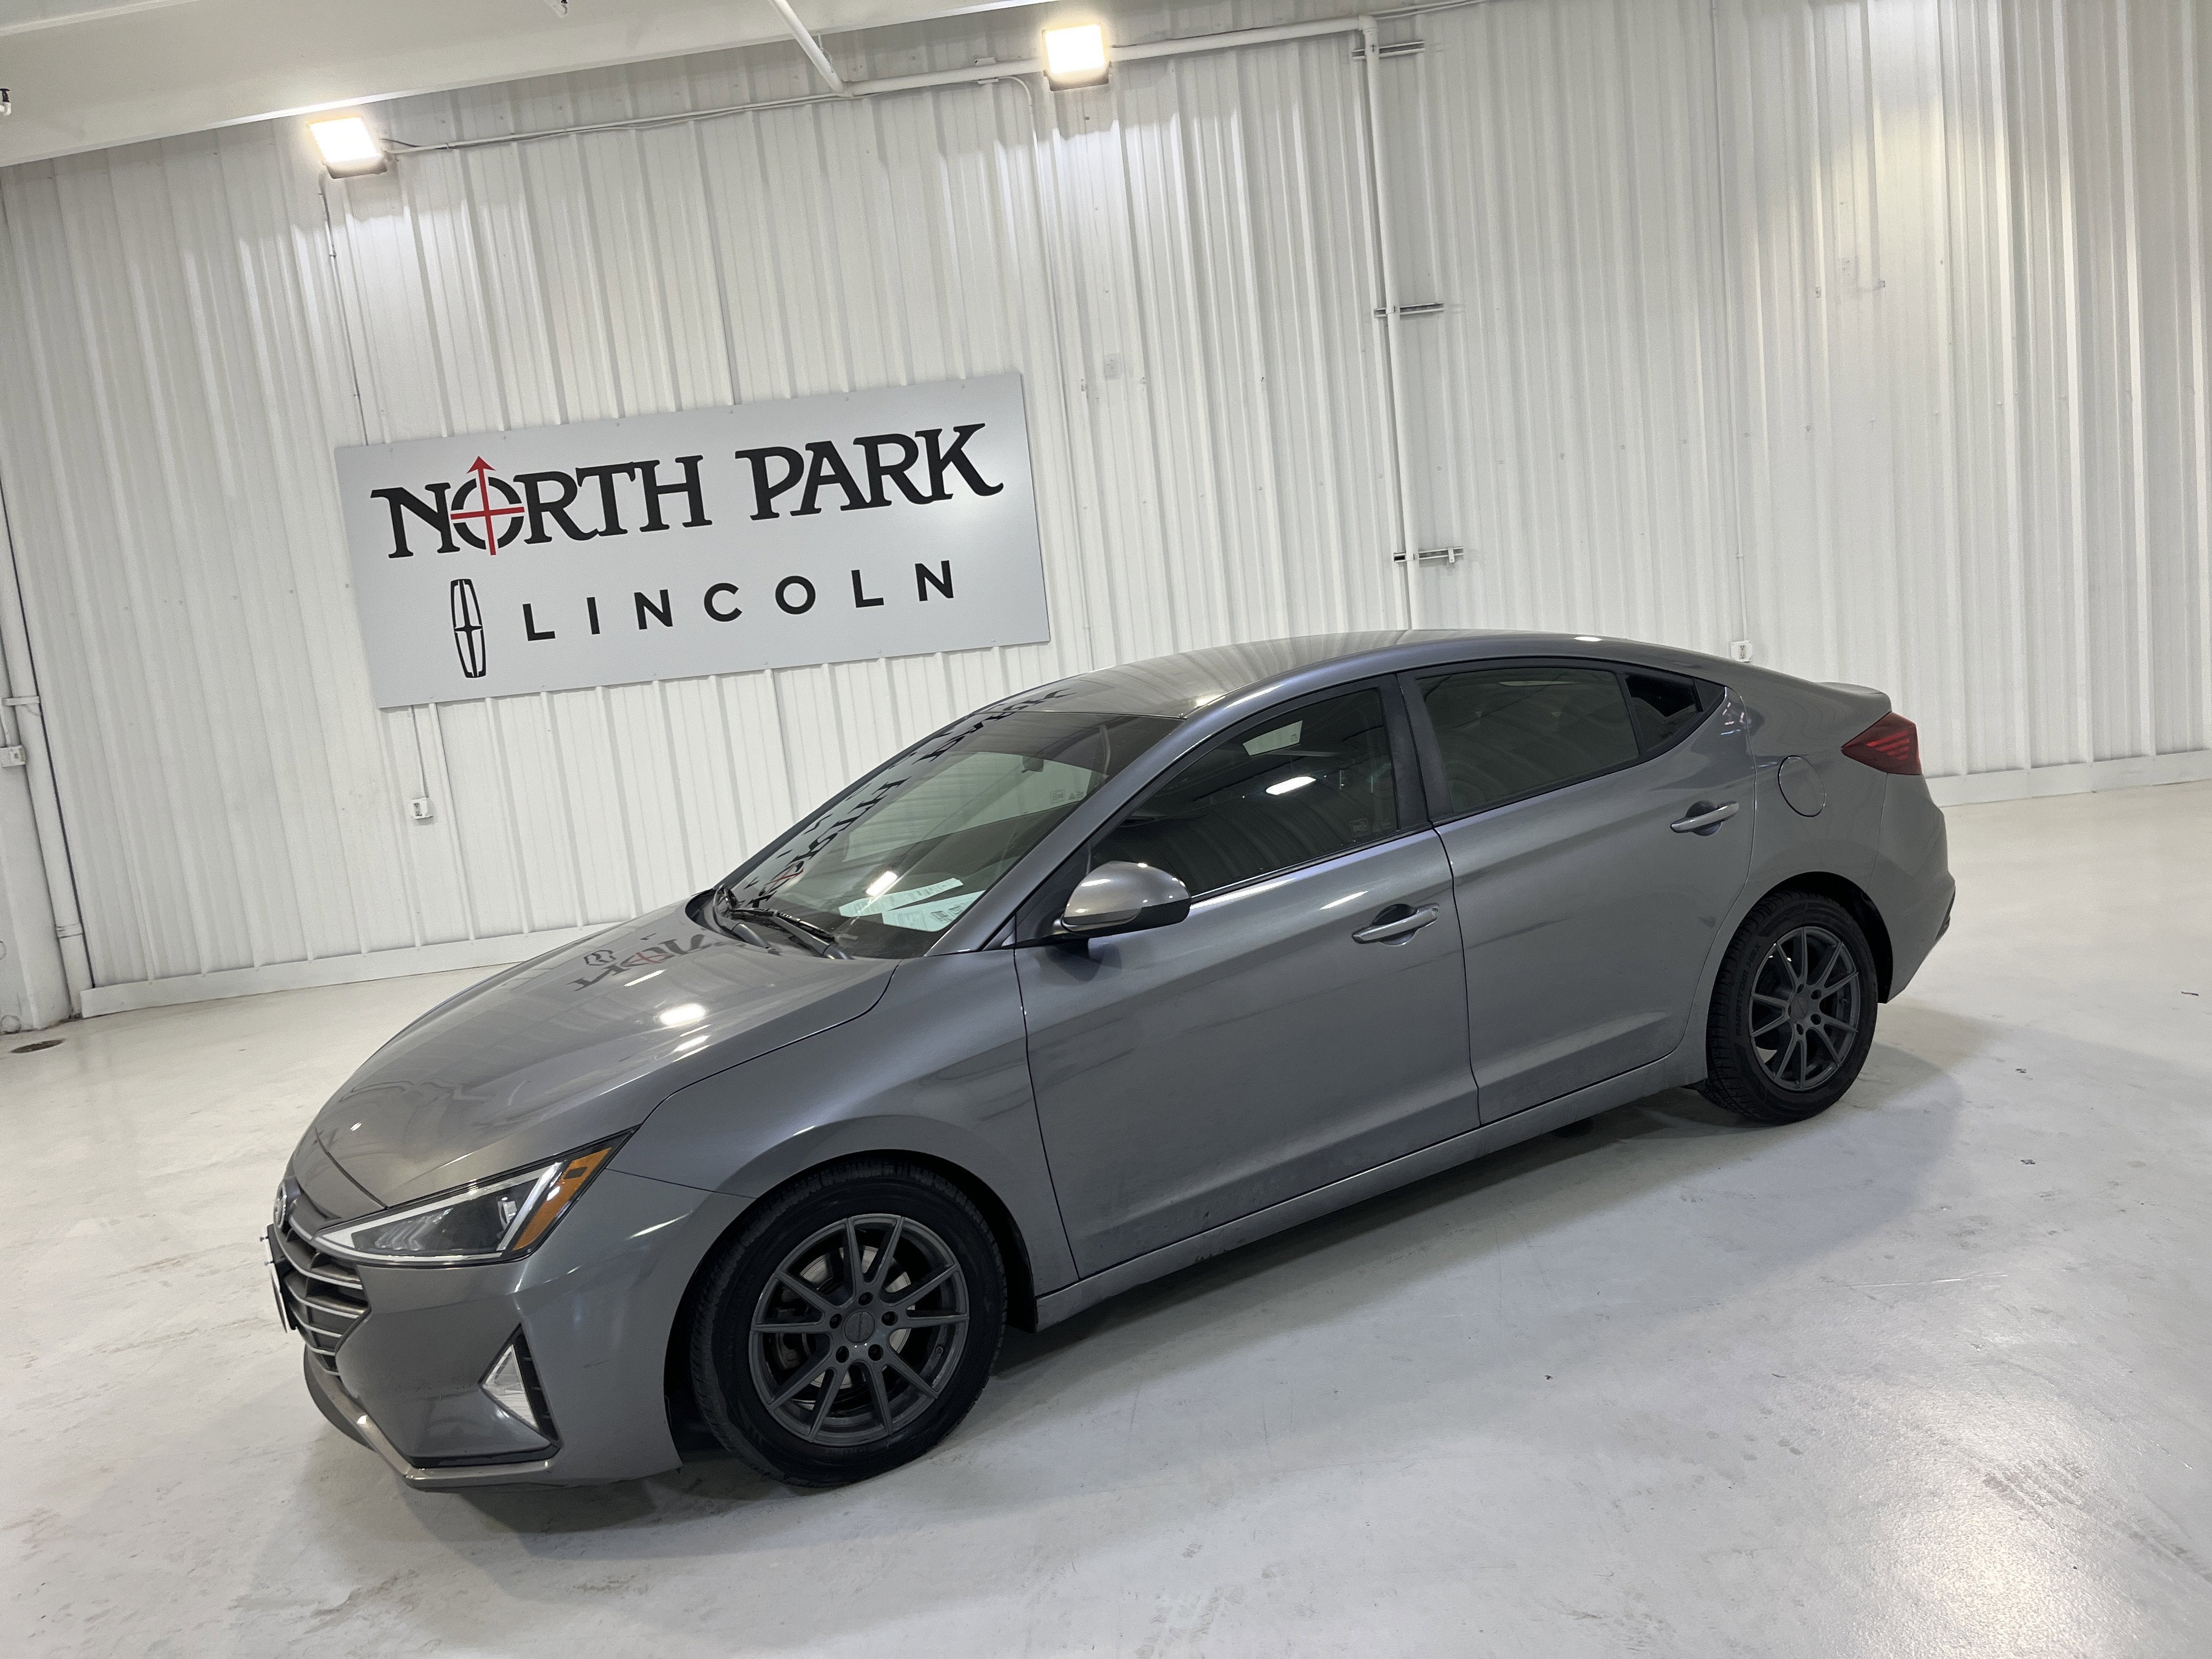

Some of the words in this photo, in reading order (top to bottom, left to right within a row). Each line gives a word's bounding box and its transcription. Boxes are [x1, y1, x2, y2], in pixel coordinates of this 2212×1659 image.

[370, 455, 713, 558] NORTH
[735, 424, 1004, 521] PARK
[523, 560, 954, 641] LINCOLN
